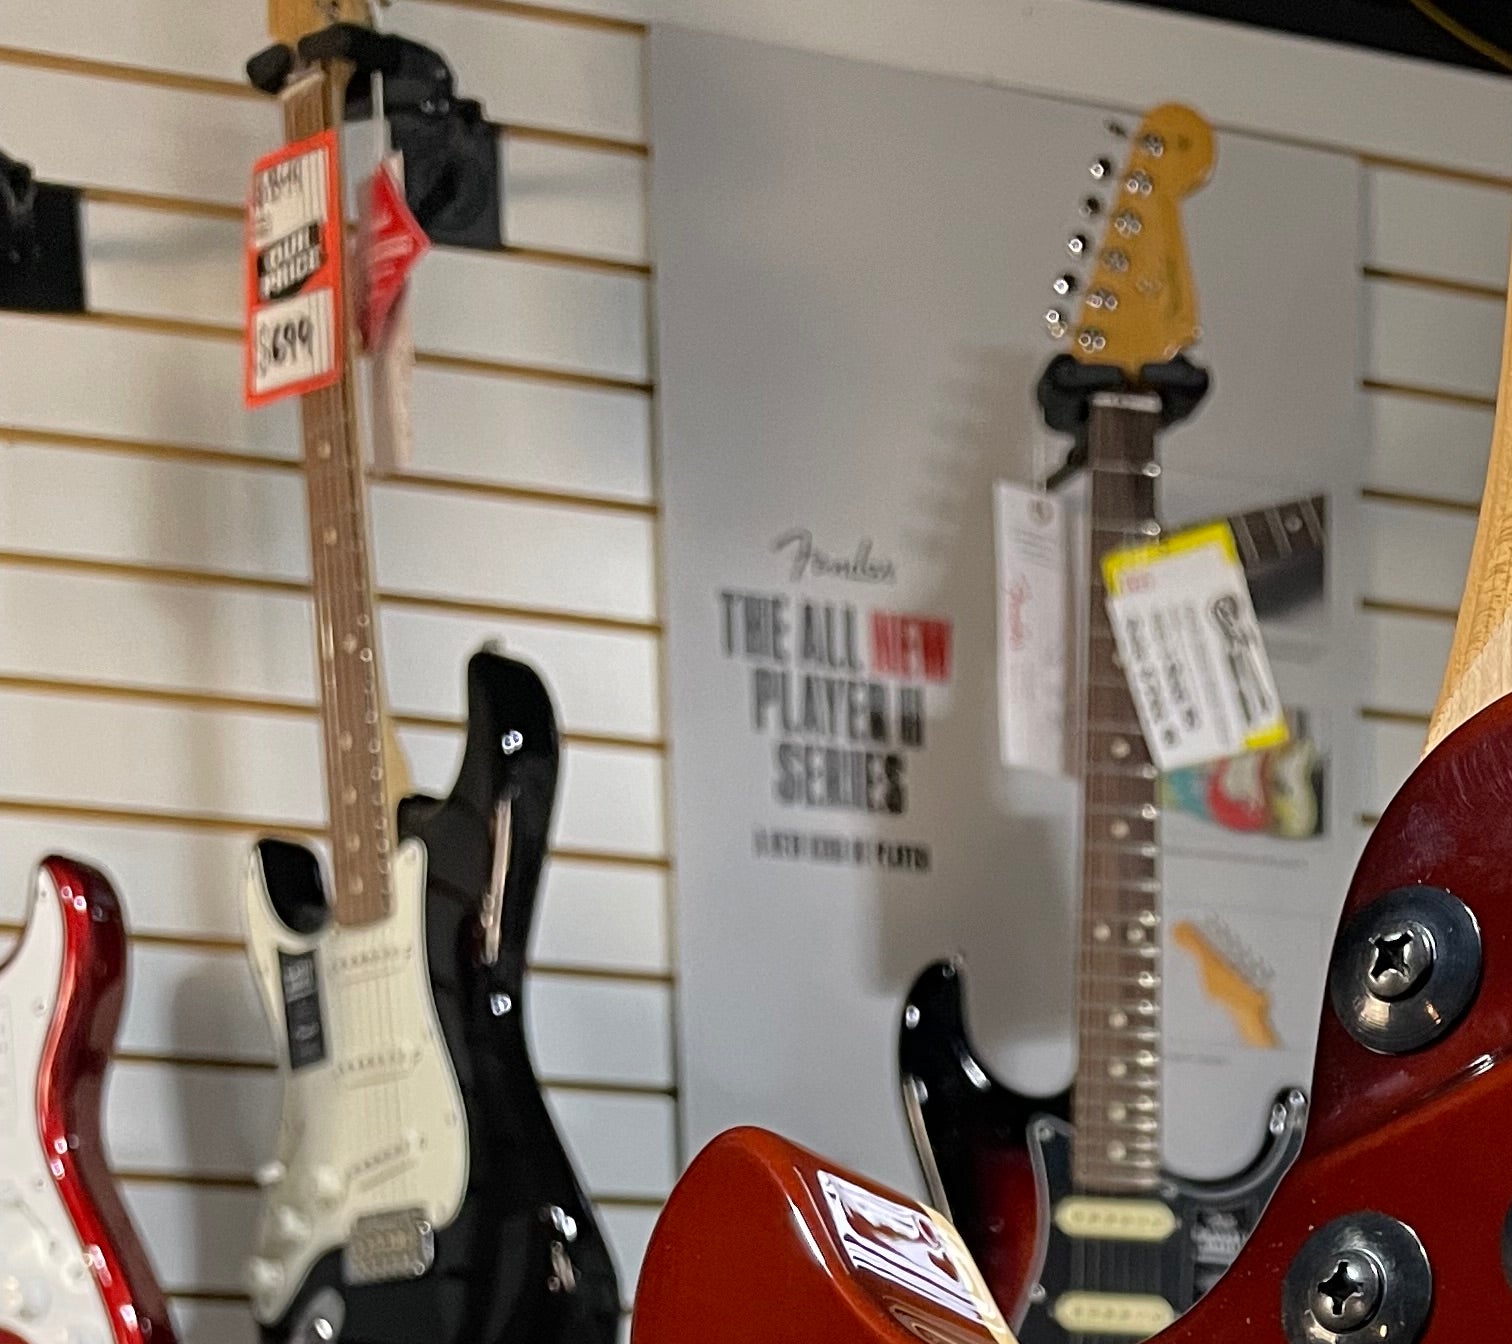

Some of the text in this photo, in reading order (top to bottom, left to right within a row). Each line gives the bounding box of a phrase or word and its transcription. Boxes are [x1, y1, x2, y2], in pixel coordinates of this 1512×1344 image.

[261, 247, 322, 299] PRICE
[772, 528, 896, 584] Fender
[719, 589, 952, 683] THE ALL NEW
[754, 667, 889, 743] PLAYER
[774, 743, 906, 814] SERIES
